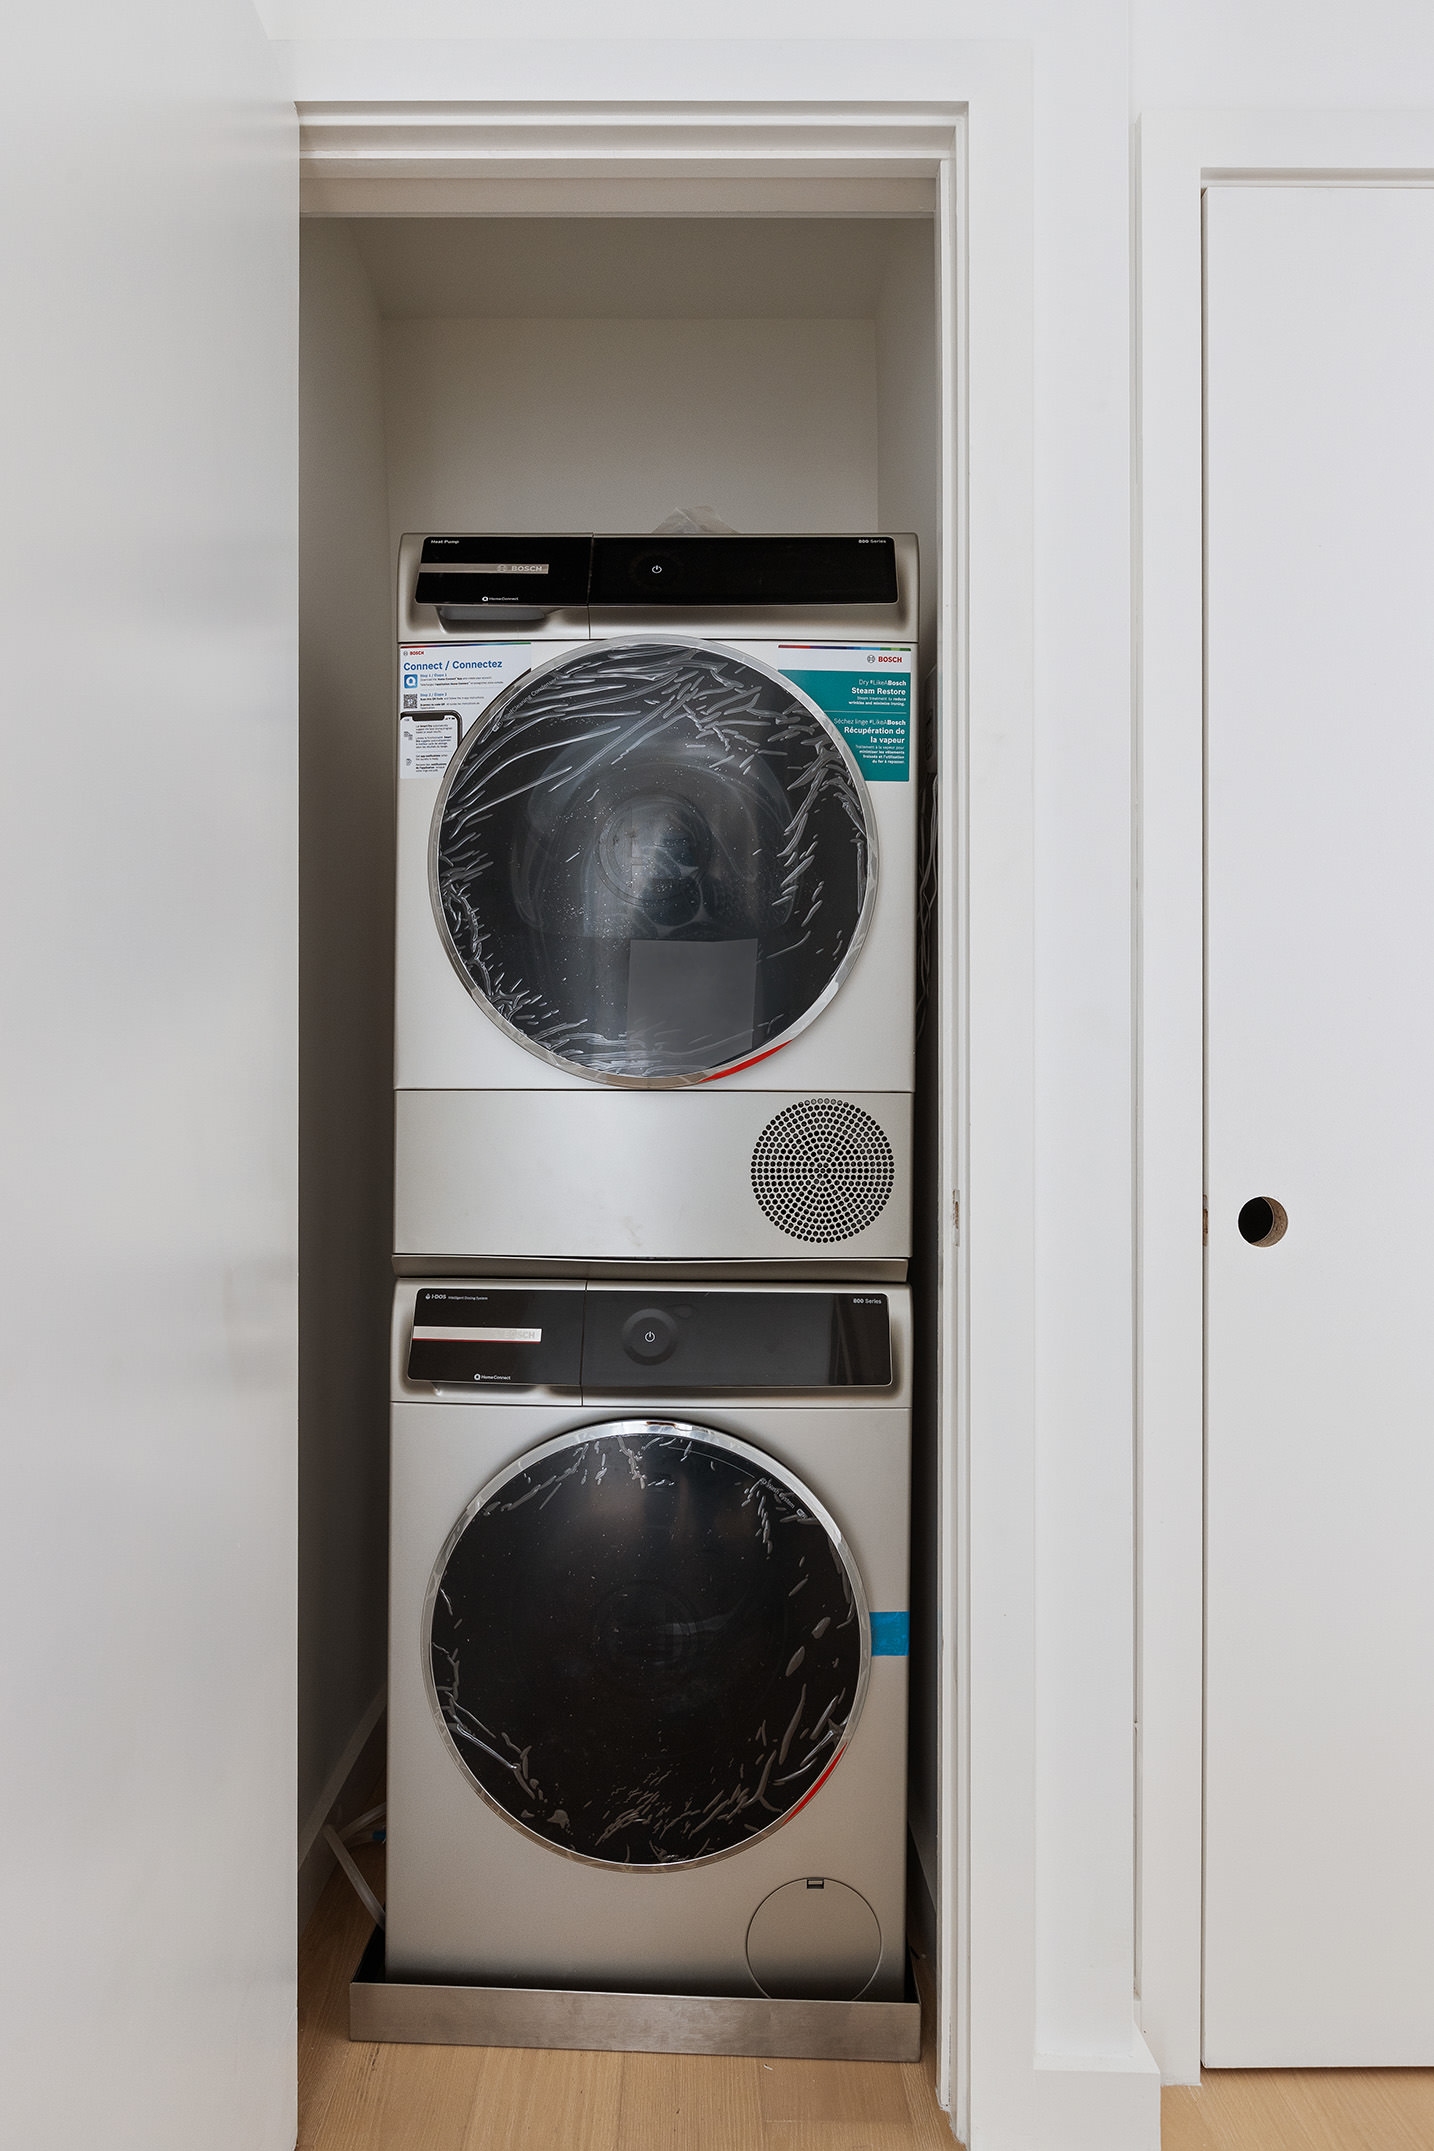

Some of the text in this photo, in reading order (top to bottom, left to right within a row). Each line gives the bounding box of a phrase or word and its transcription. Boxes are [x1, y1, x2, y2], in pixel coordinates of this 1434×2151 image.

[403, 662, 442, 671] Connect
[452, 660, 503, 670] Connectez
[877, 687, 906, 695] Restore
[844, 726, 893, 735] Récupération
